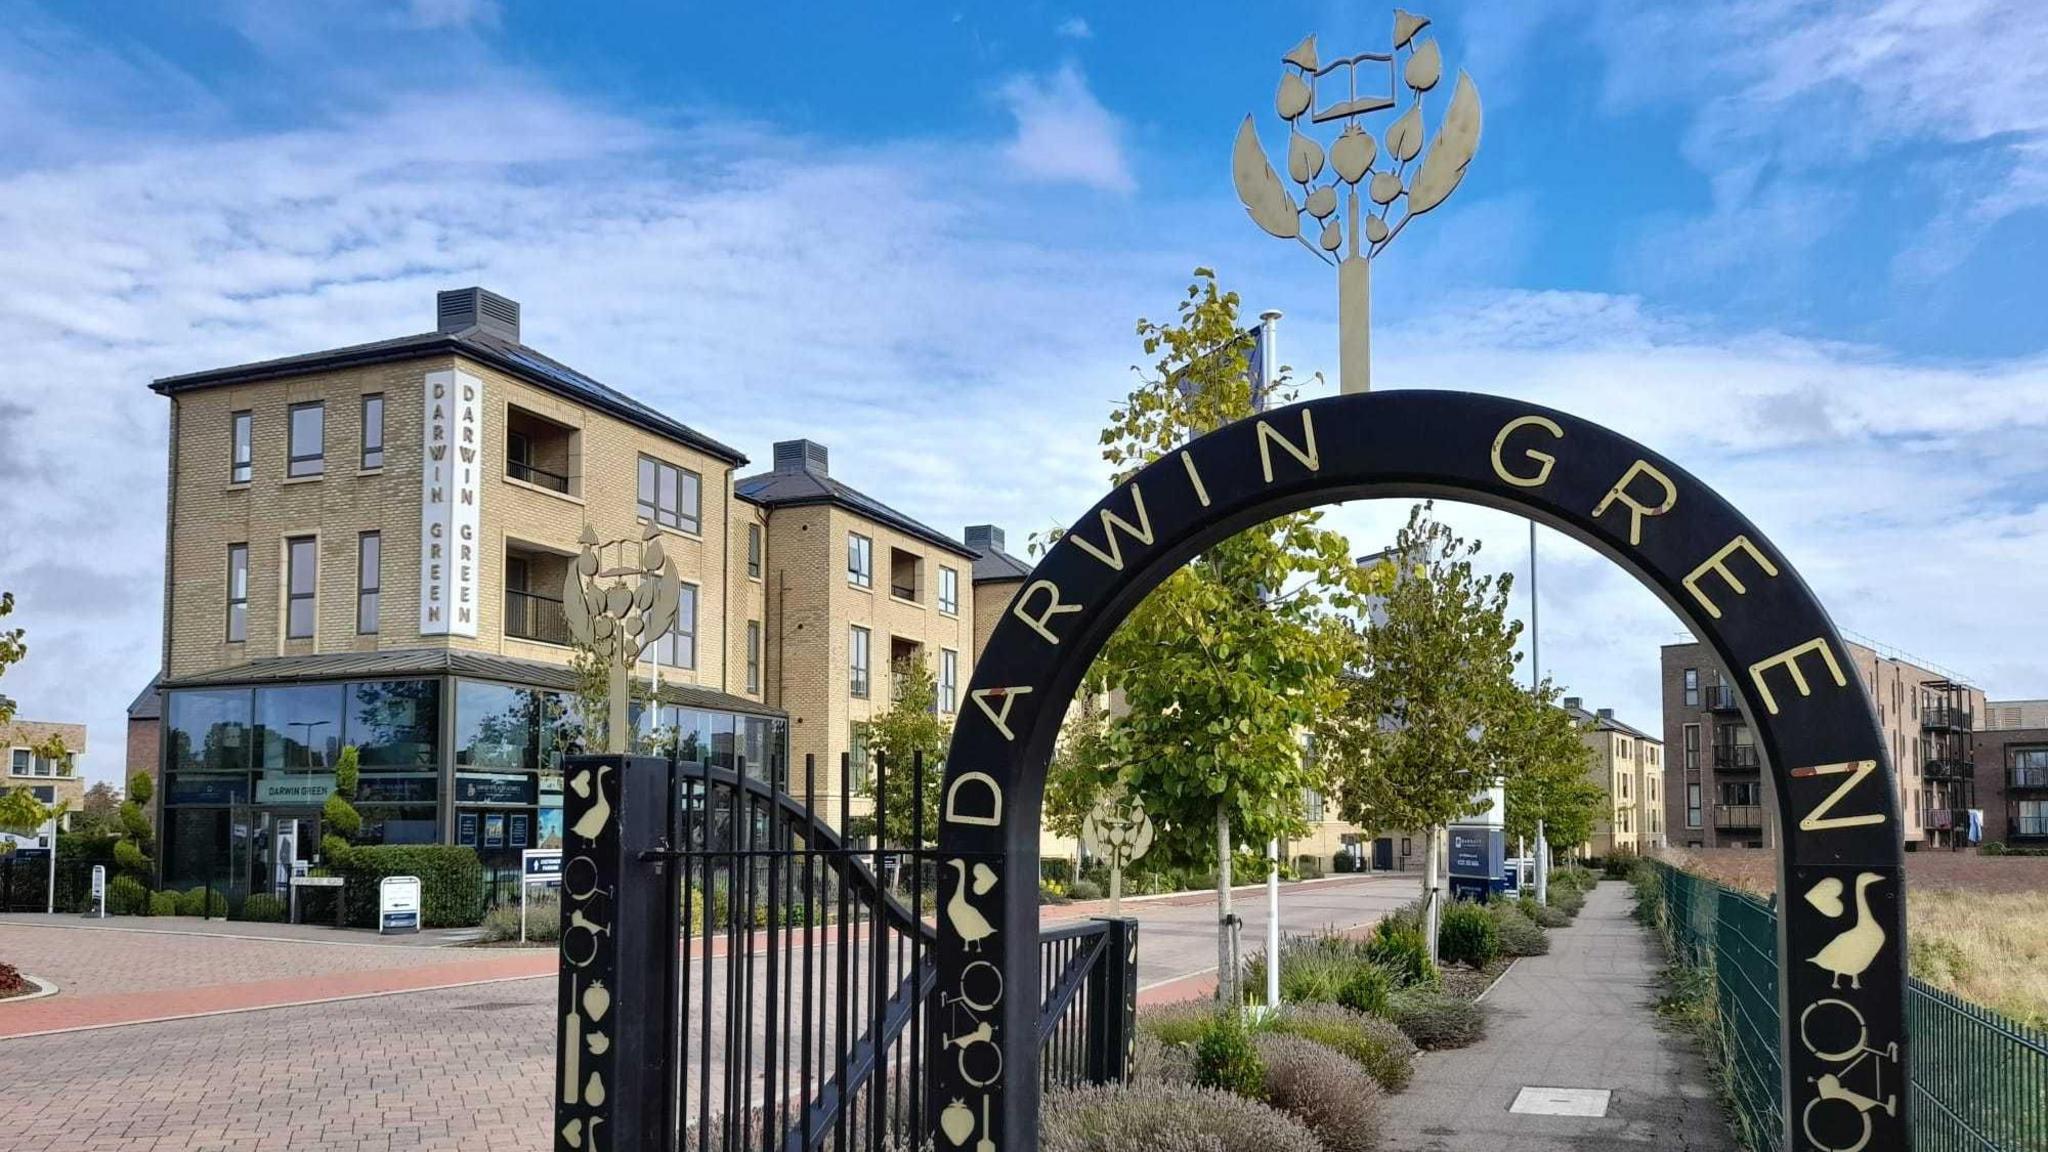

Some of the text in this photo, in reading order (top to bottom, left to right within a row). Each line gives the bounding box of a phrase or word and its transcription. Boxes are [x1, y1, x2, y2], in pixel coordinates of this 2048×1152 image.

[428, 383, 448, 623] DARWIN GREEN
[458, 385, 476, 624] DARWIN GREEN
[946, 407, 1886, 831] DARWIN GREEN
[268, 786, 328, 796] DARWIN GREEN
